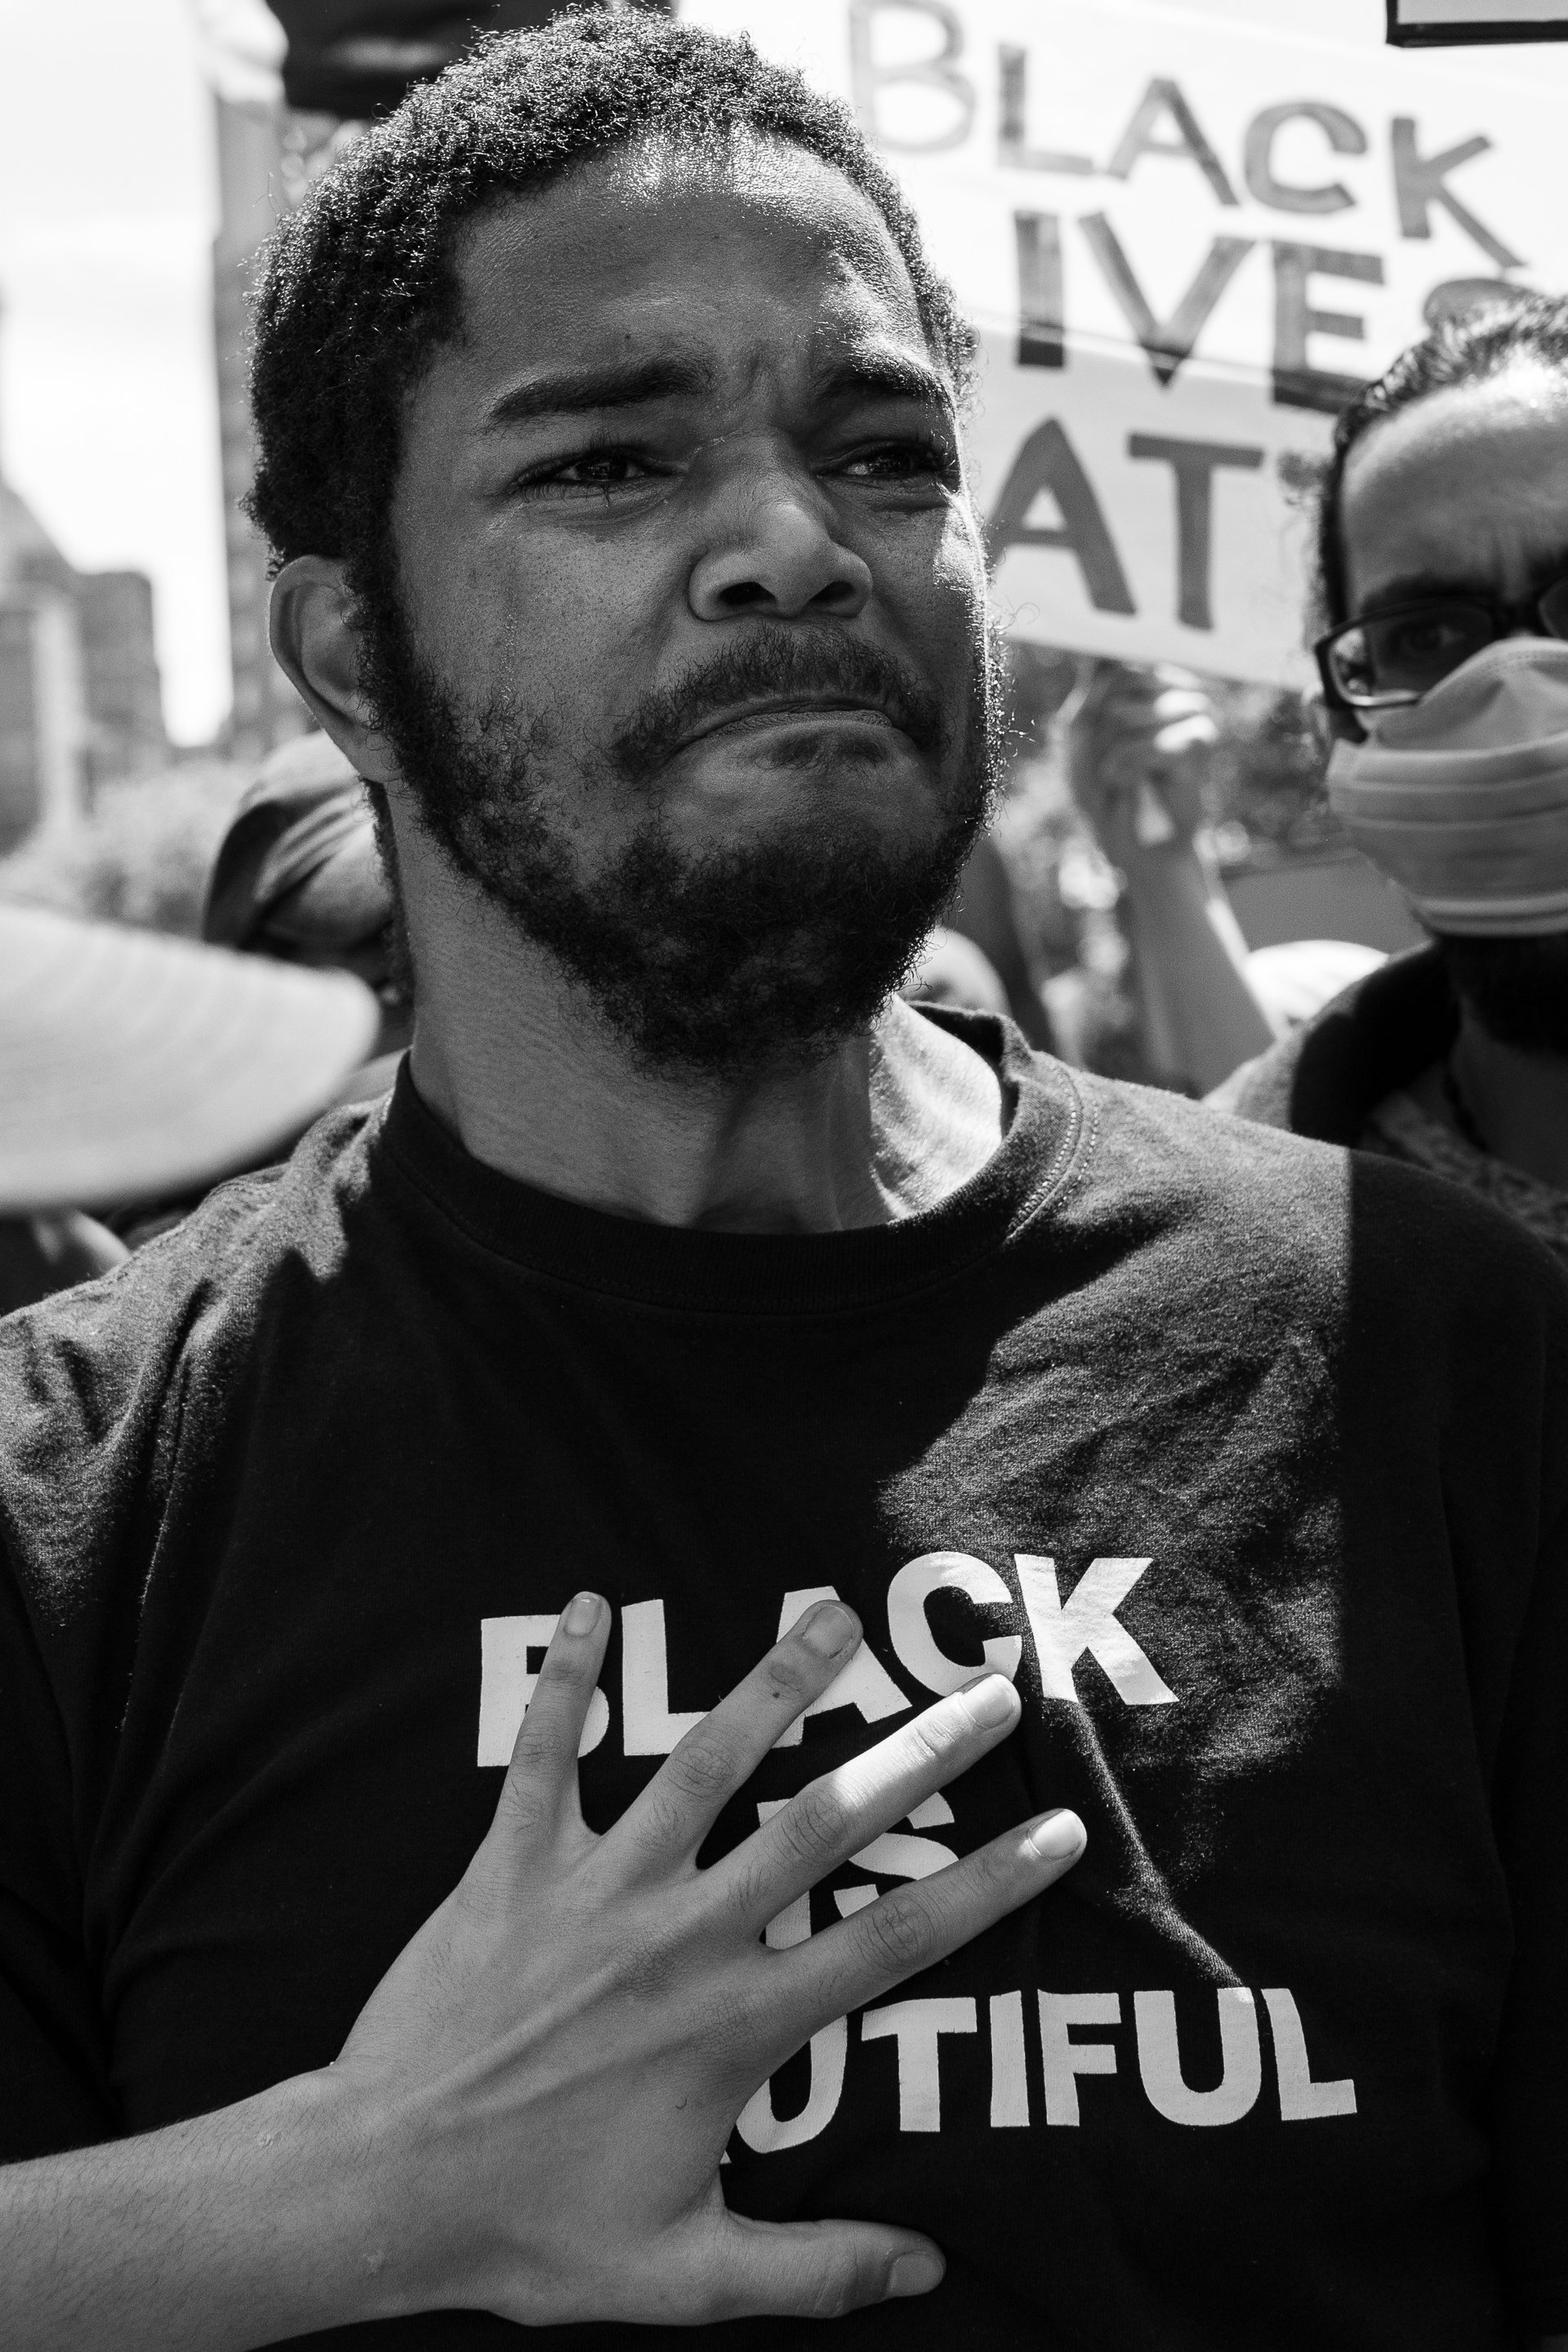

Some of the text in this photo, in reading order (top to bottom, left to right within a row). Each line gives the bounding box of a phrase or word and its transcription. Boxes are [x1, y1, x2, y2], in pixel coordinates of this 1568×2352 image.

[847, 0, 1526, 269] BLACK
[1011, 209, 1542, 416] IVE
[477, 1551, 1180, 1767] BLACK
[719, 1986, 1358, 2164] UTIFUL
